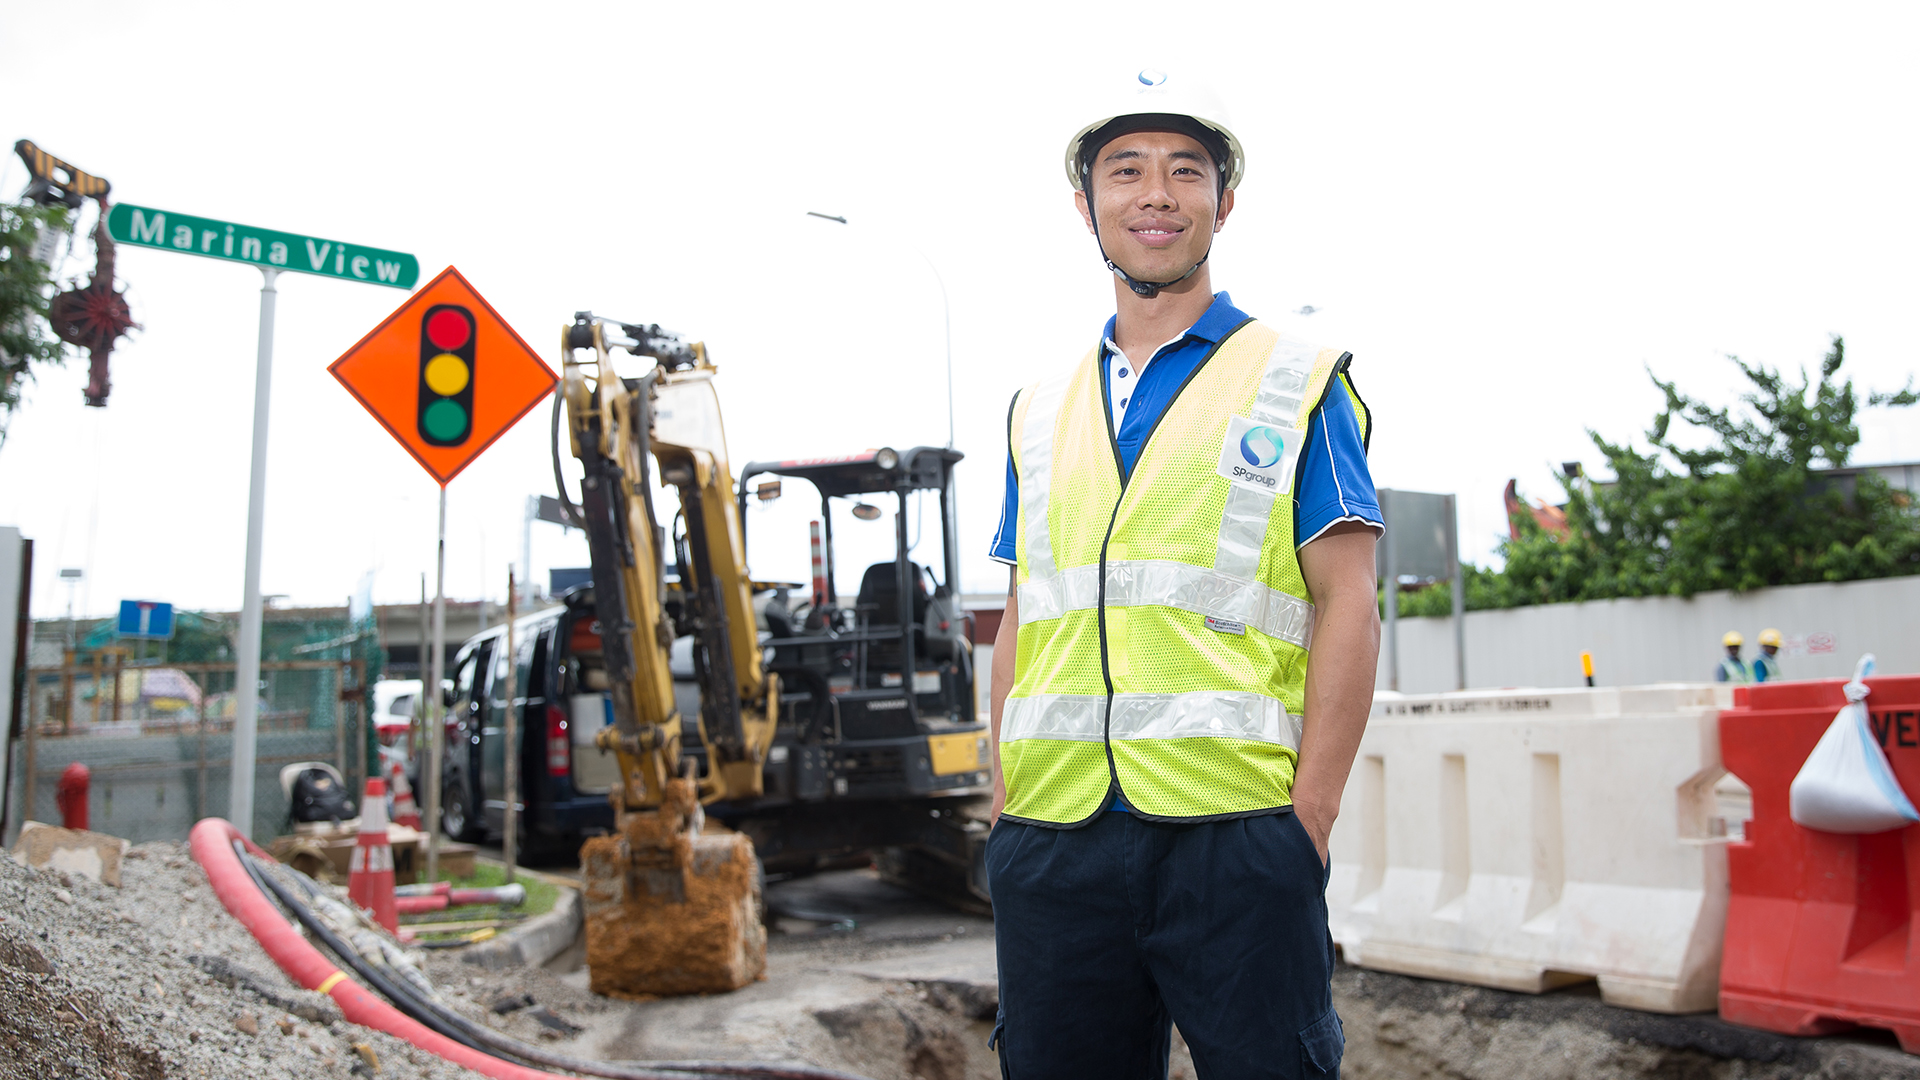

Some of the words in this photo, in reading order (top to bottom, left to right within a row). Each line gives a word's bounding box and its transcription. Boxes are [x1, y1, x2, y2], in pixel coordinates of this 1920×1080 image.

[130, 209, 288, 265] Marina
[305, 239, 401, 283] View
[1232, 466, 1276, 487] SPgroup
[1871, 711, 1920, 748] VE
